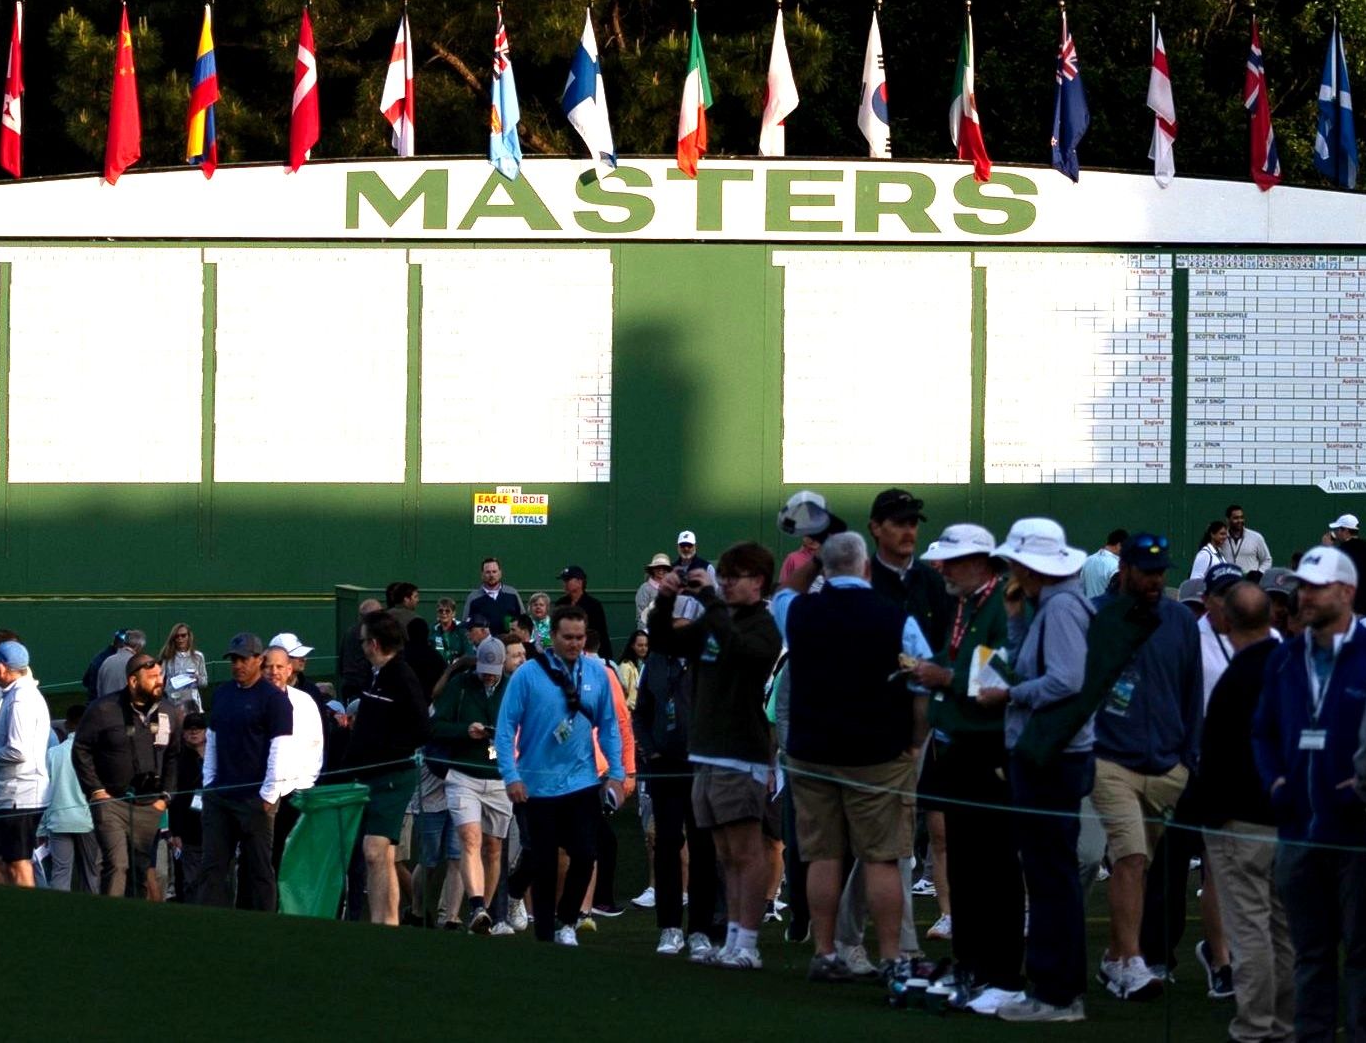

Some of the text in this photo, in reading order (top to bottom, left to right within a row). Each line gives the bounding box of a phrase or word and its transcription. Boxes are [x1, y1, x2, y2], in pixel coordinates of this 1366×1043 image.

[346, 167, 1039, 236] MASTERS
[1329, 480, 1348, 490] AMEN
[478, 495, 508, 503] EAGLE
[477, 505, 496, 513] PAR
[476, 515, 544, 524] BOGEY TOTALS
